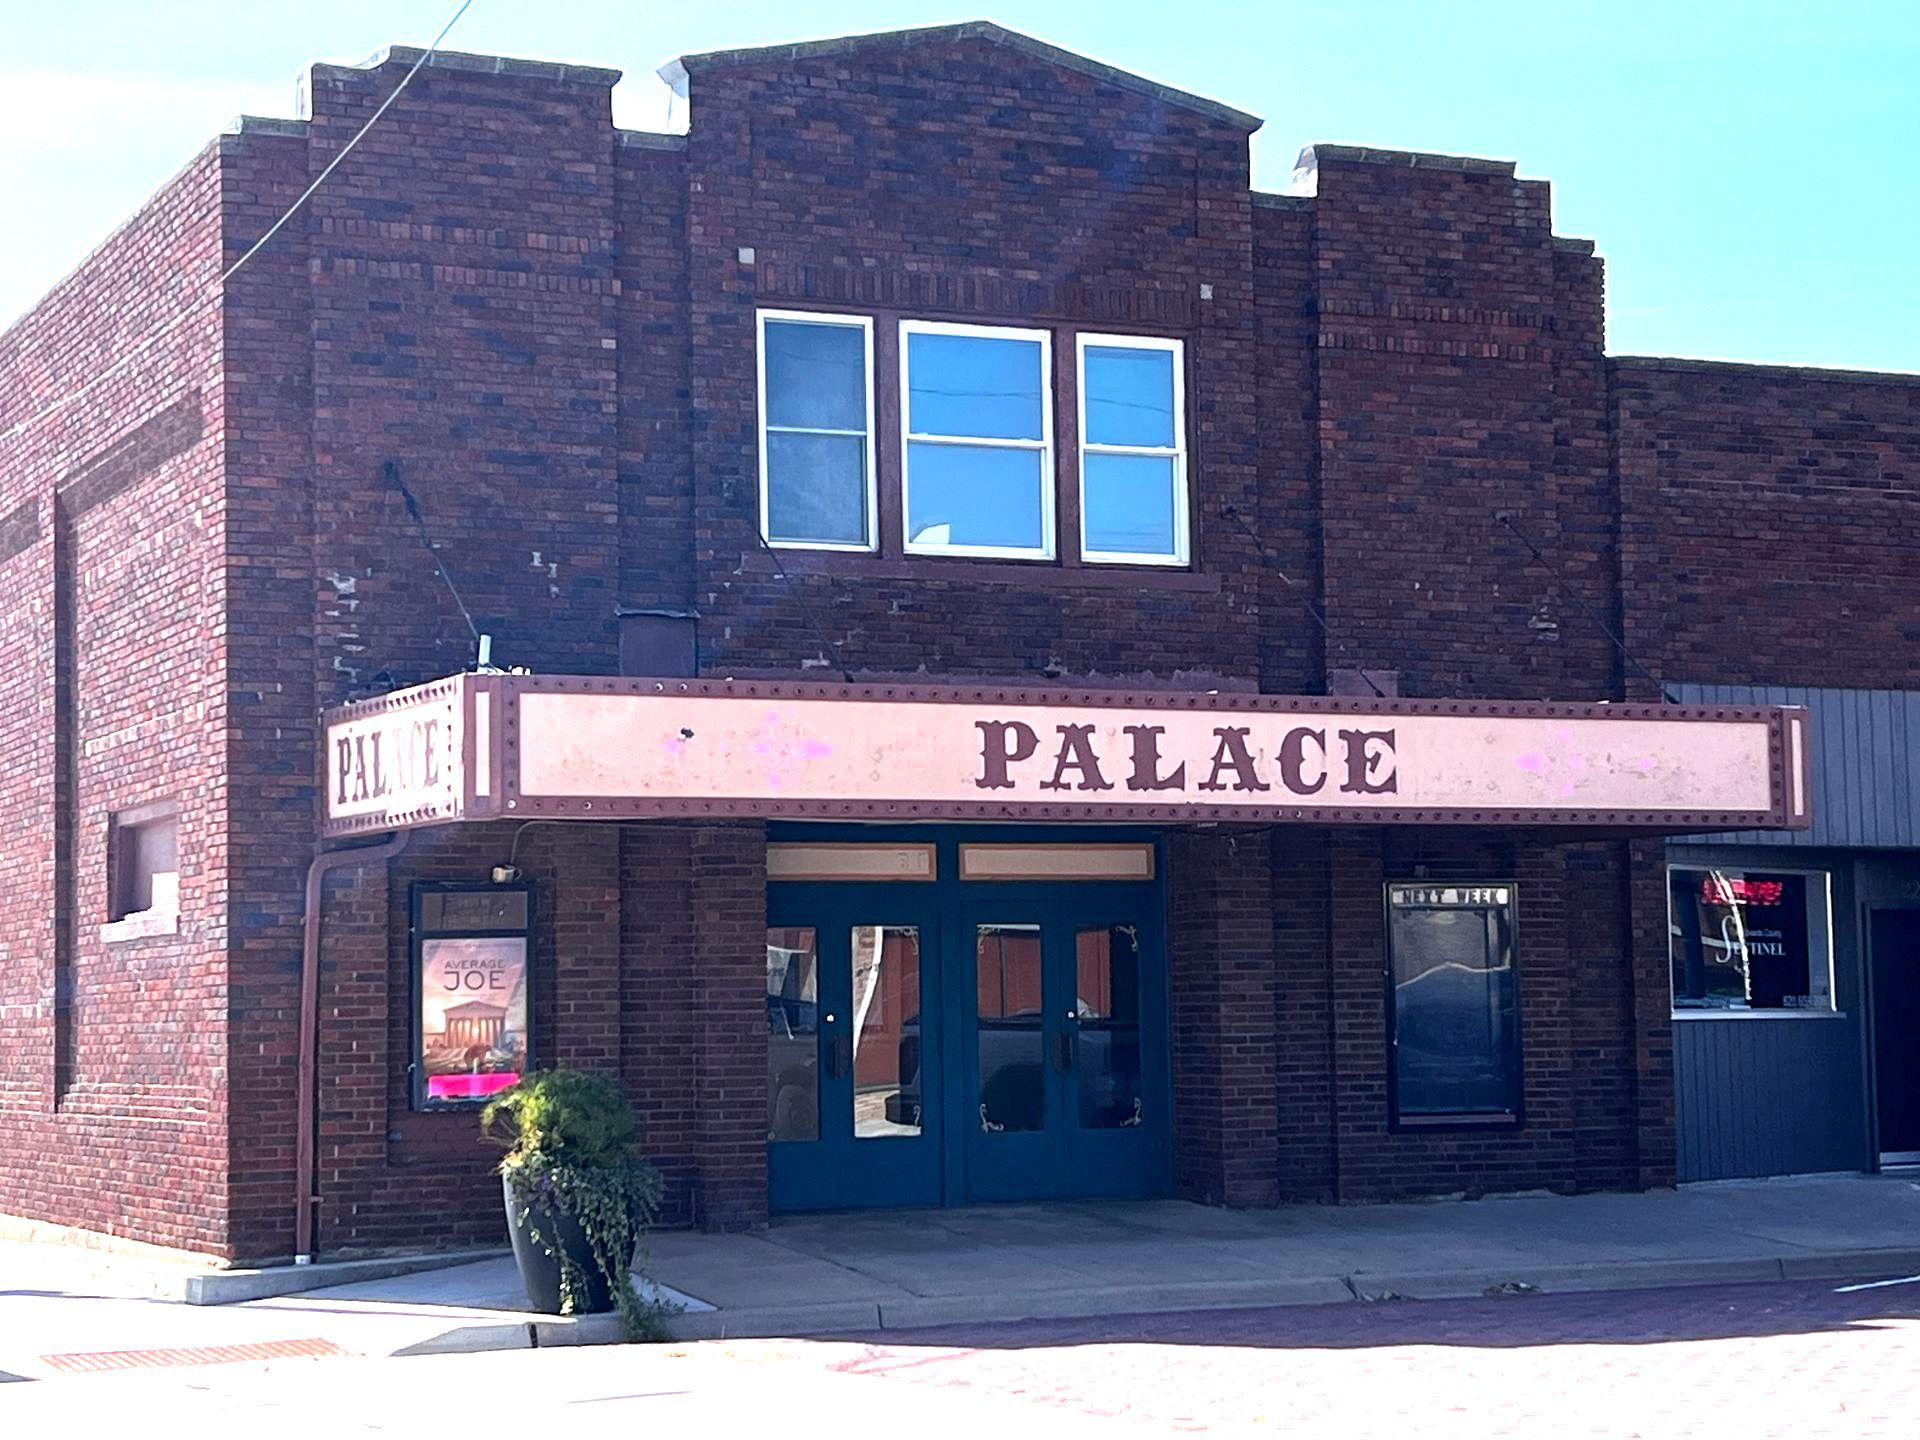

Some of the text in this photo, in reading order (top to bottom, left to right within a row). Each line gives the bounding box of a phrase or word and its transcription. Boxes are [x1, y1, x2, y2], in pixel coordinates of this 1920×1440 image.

[975, 720, 1398, 794] PALACE
[1403, 888, 1444, 904] NEXT
[1715, 915, 1786, 963] SETINEL
[444, 959, 506, 969] AVERAGE
[443, 970, 506, 991] JOE
